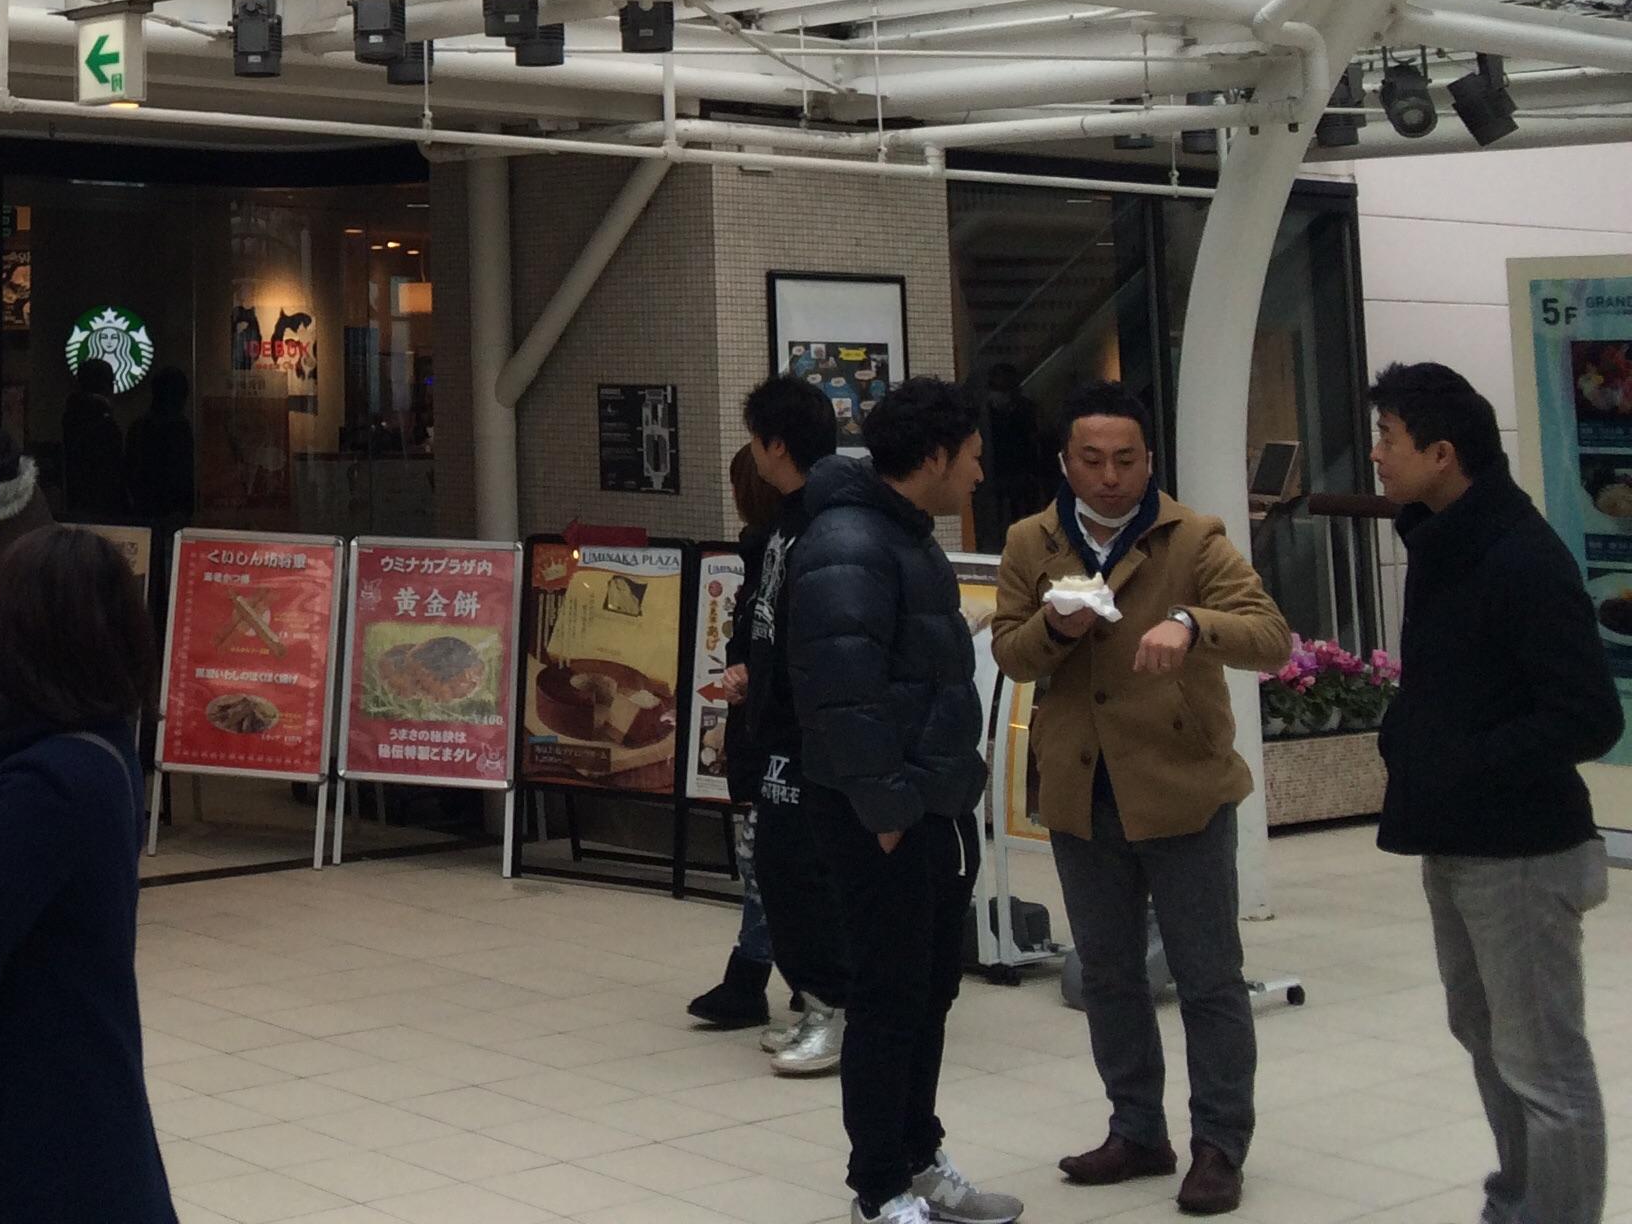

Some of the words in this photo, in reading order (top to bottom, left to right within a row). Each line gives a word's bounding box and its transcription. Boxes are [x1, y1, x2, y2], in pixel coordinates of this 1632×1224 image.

[1541, 297, 1578, 326] 5F
[380, 555, 493, 577] ウミナカプラザ内
[582, 550, 639, 566] UMINAKA
[642, 554, 680, 567] PLAZA
[708, 564, 744, 576] UMINAK
[392, 586, 481, 619] 黄金餅
